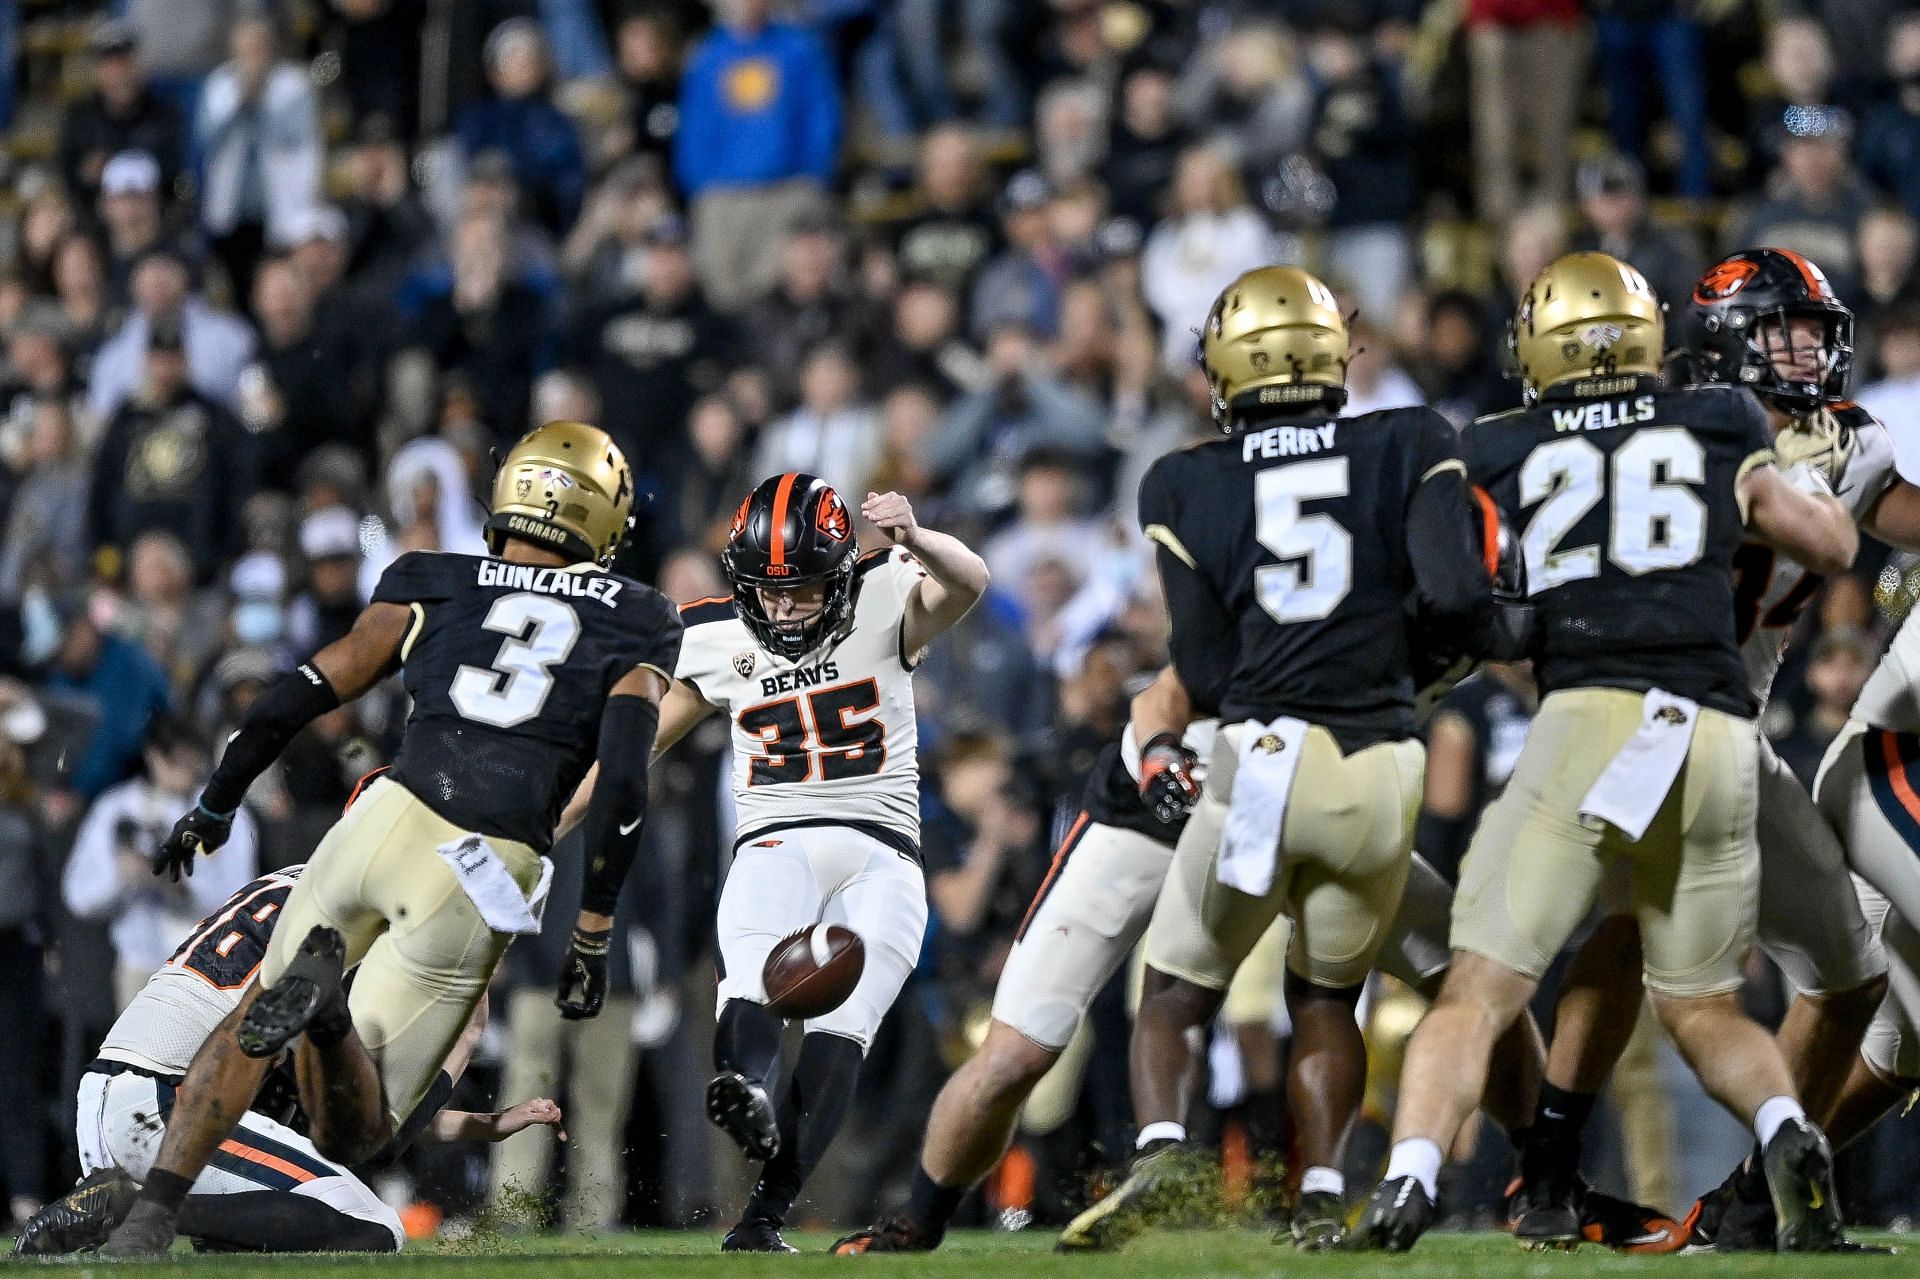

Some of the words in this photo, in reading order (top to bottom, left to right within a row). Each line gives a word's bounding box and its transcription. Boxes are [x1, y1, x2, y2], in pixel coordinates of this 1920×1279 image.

[1552, 395, 1655, 432] WELLS
[1242, 421, 1337, 463] PERRY
[508, 515, 567, 544] COLORADO
[1518, 425, 1709, 597] 26
[1254, 455, 1353, 625] 5
[477, 559, 623, 609] GONZALEZ
[766, 565, 790, 576] OSU
[448, 591, 582, 729] 3
[761, 662, 839, 697] BEAVS
[737, 676, 888, 788] 35
